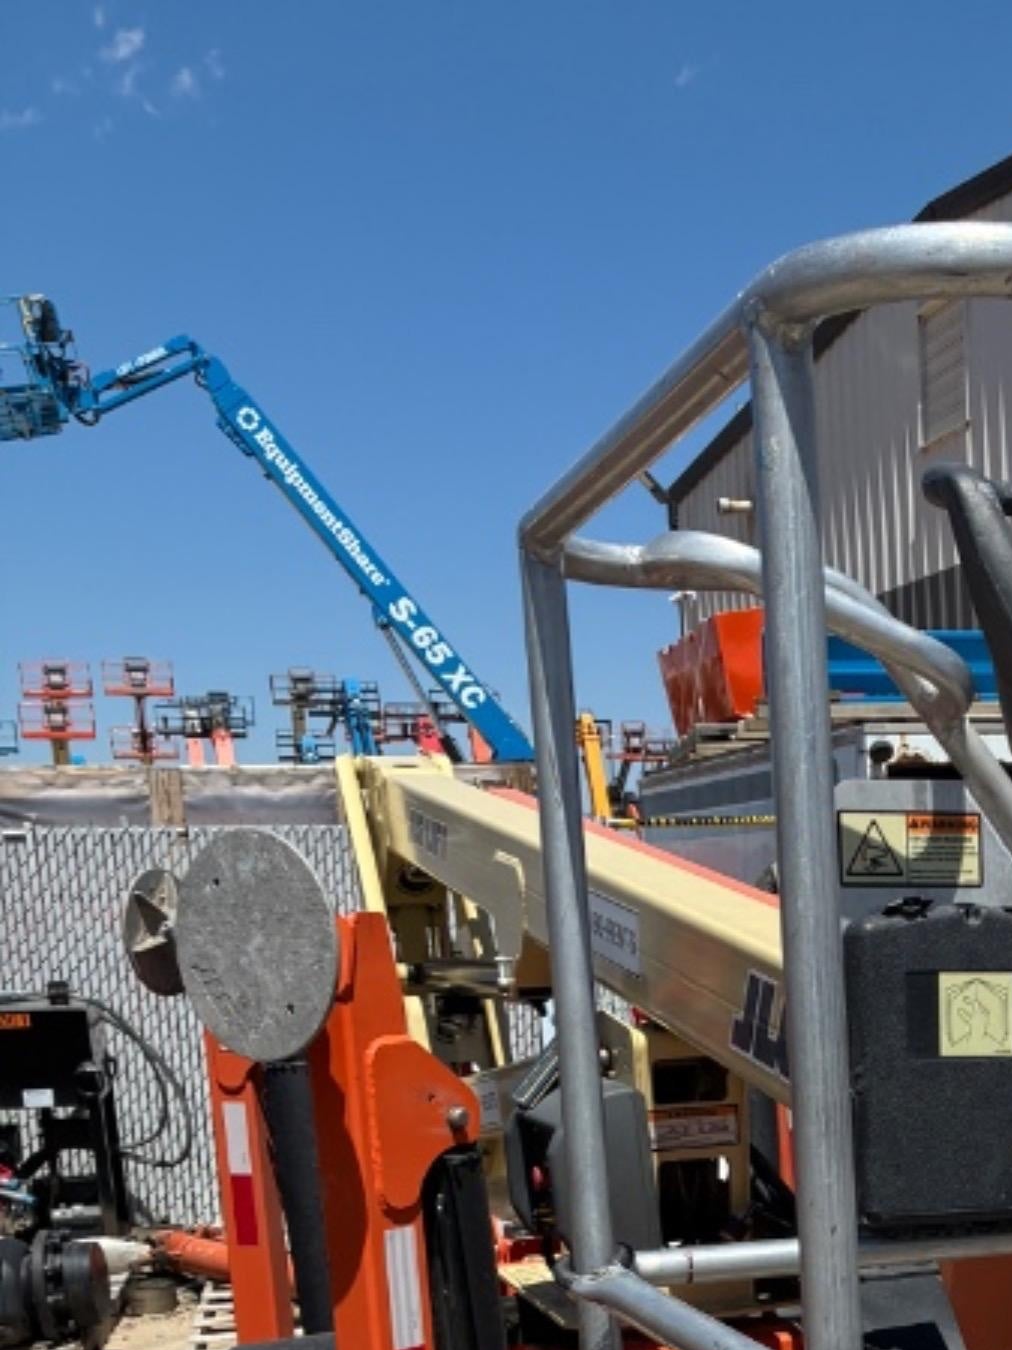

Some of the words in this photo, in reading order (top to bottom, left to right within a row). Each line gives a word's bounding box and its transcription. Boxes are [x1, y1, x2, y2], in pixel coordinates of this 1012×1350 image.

[254, 426, 387, 586] EquipmentShare
[388, 596, 454, 665] S-65
[441, 665, 487, 710] XC
